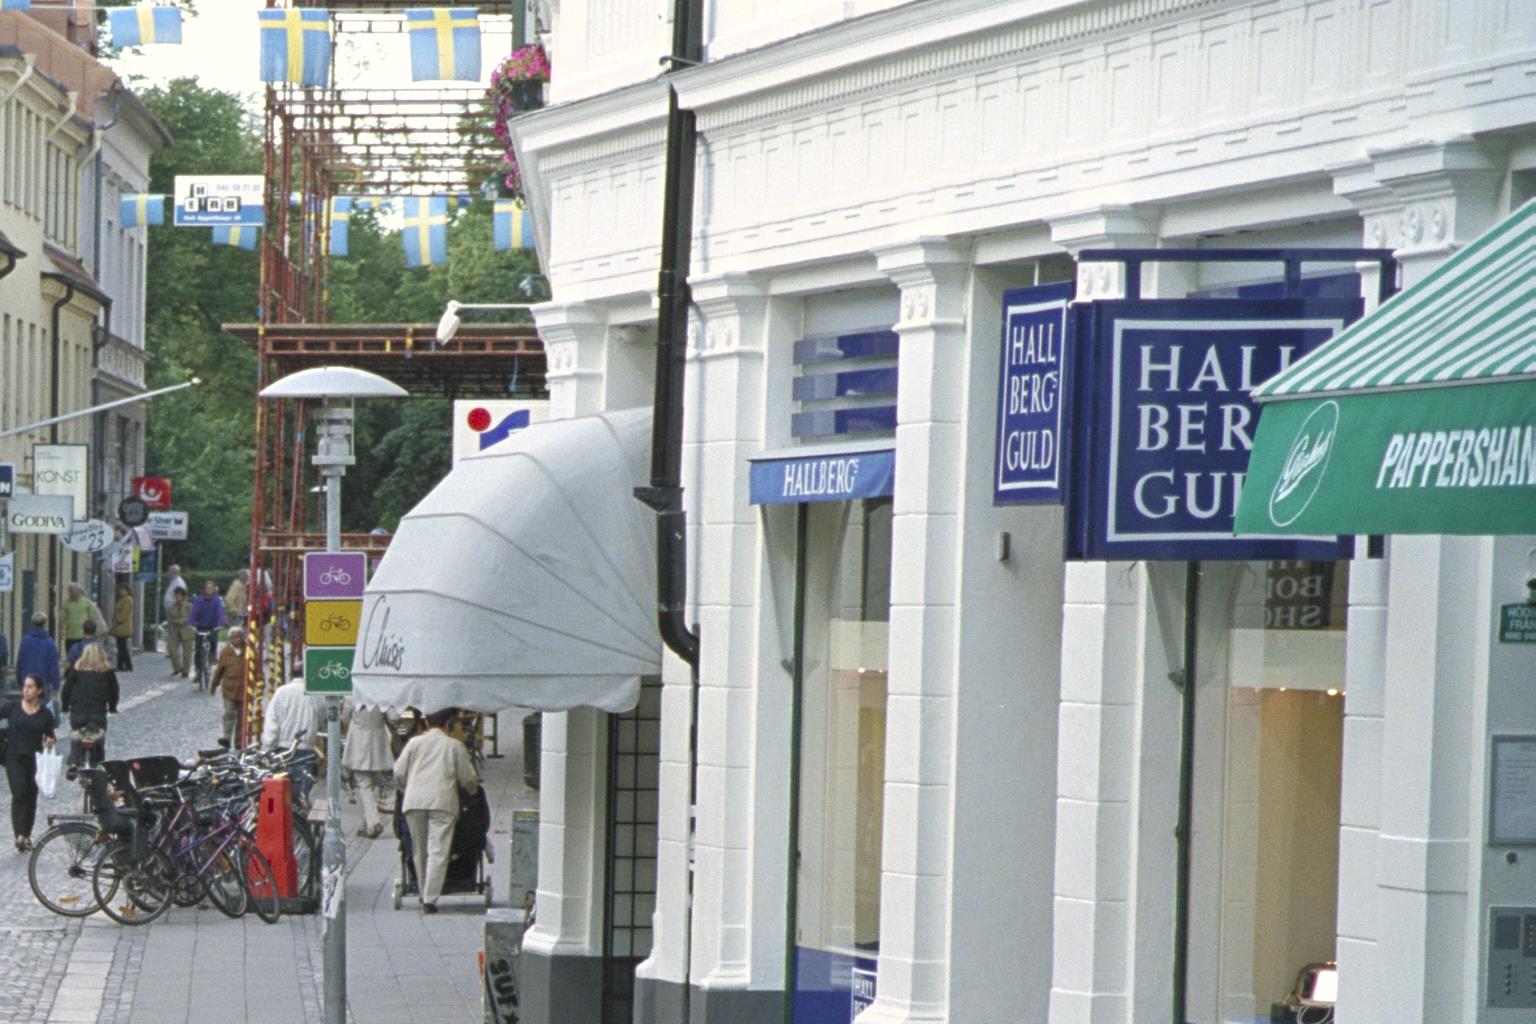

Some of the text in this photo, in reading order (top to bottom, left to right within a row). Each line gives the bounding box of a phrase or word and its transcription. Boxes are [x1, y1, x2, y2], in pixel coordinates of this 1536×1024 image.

[1012, 323, 1056, 365] HALL
[1136, 402, 1254, 453] BER
[1007, 430, 1053, 471] GULD
[36, 470, 81, 483] KONST
